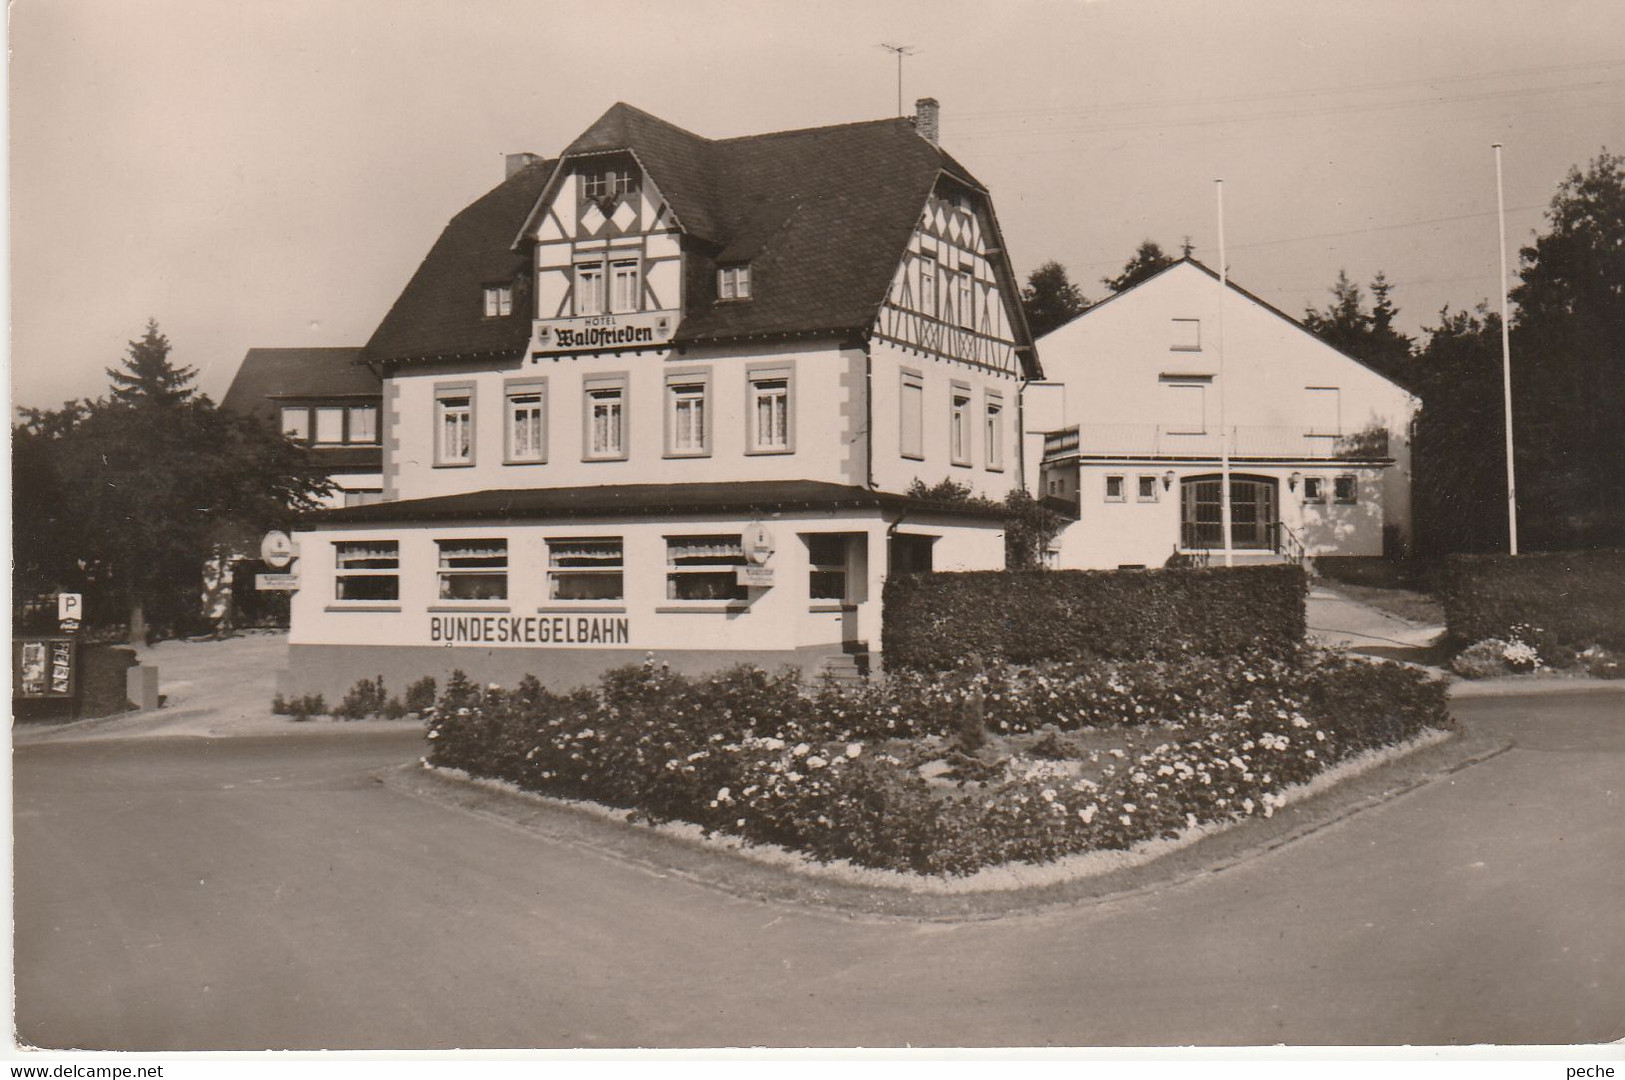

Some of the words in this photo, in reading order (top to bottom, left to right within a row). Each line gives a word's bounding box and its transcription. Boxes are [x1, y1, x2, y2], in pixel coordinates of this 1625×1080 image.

[584, 317, 617, 326] HOTEL
[554, 325, 653, 347] Waldfrieden
[65, 596, 77, 612] P
[430, 616, 629, 643] BUNDESKEGELBAHN
